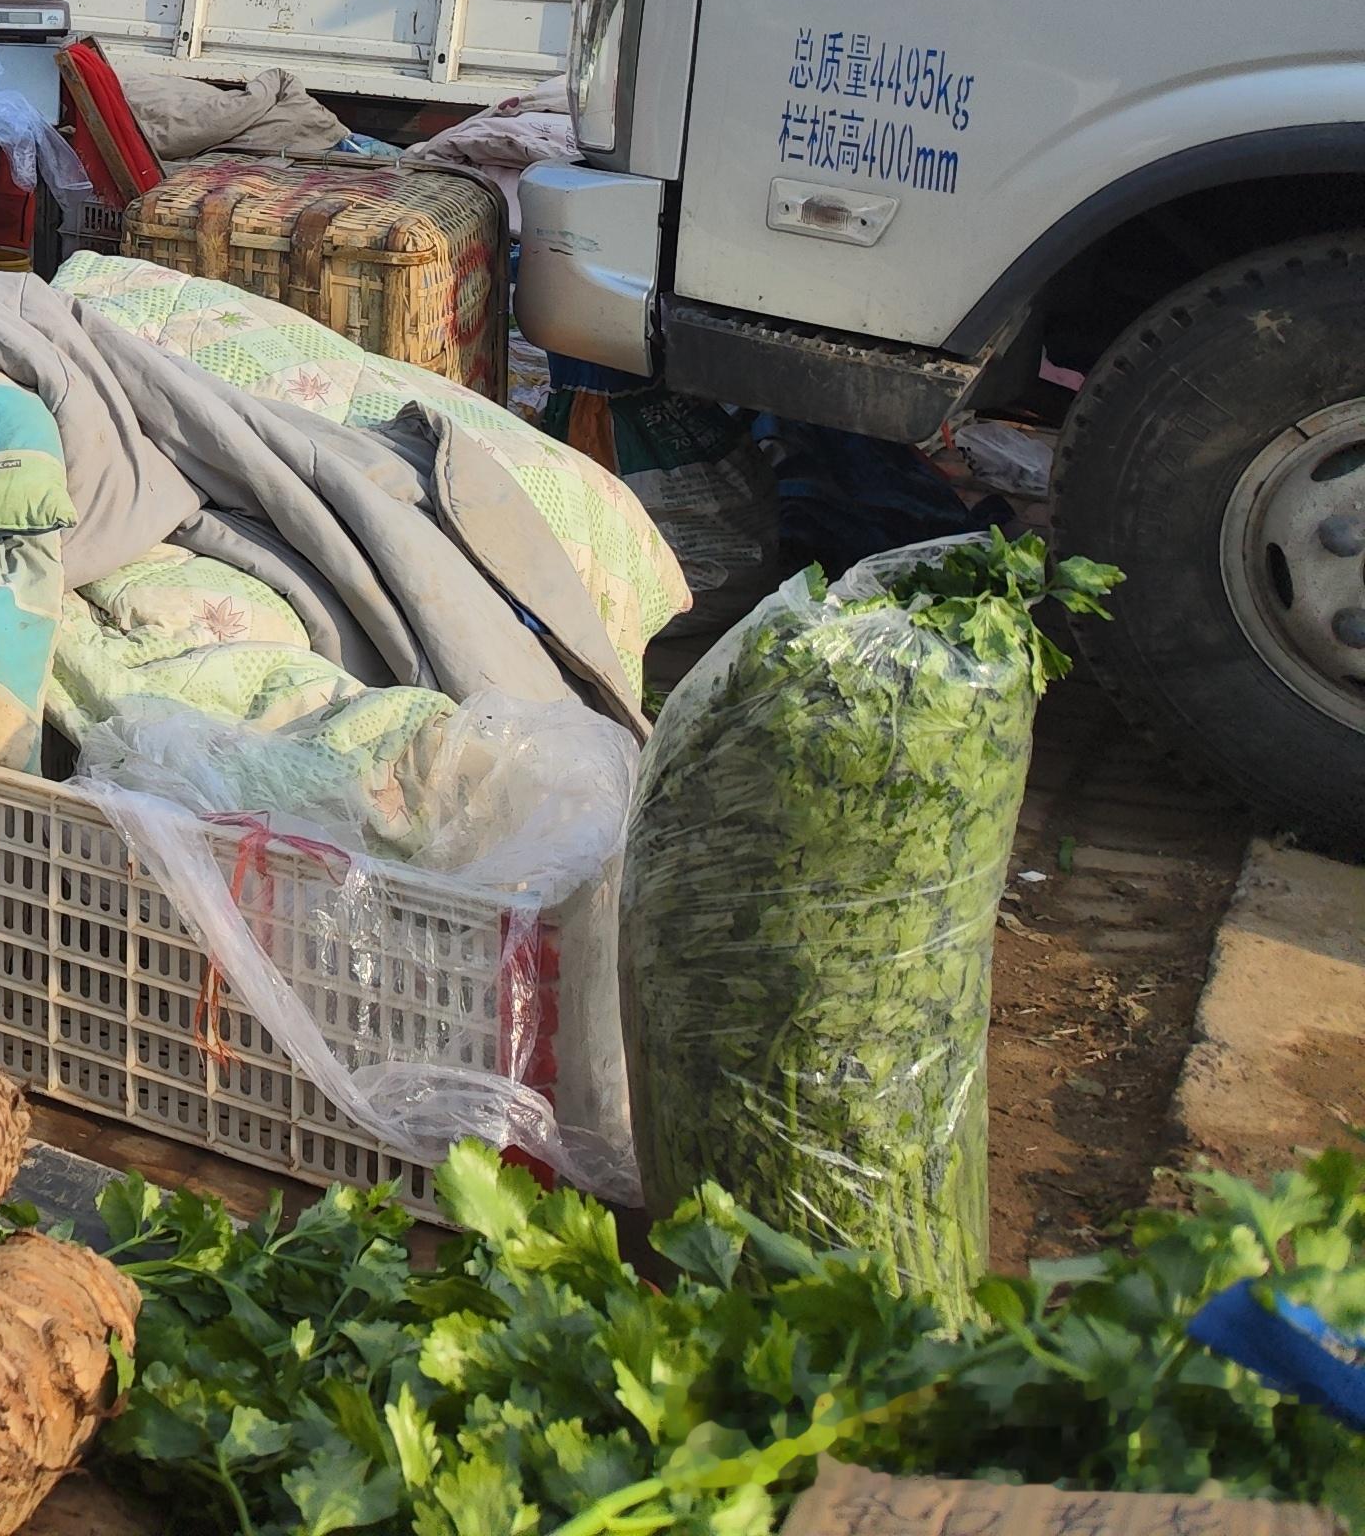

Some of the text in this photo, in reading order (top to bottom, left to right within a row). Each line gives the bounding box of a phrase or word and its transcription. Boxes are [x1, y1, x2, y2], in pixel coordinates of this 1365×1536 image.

[788, 27, 975, 131] 总质量4495kg
[778, 99, 959, 194] 栏板高400mm
